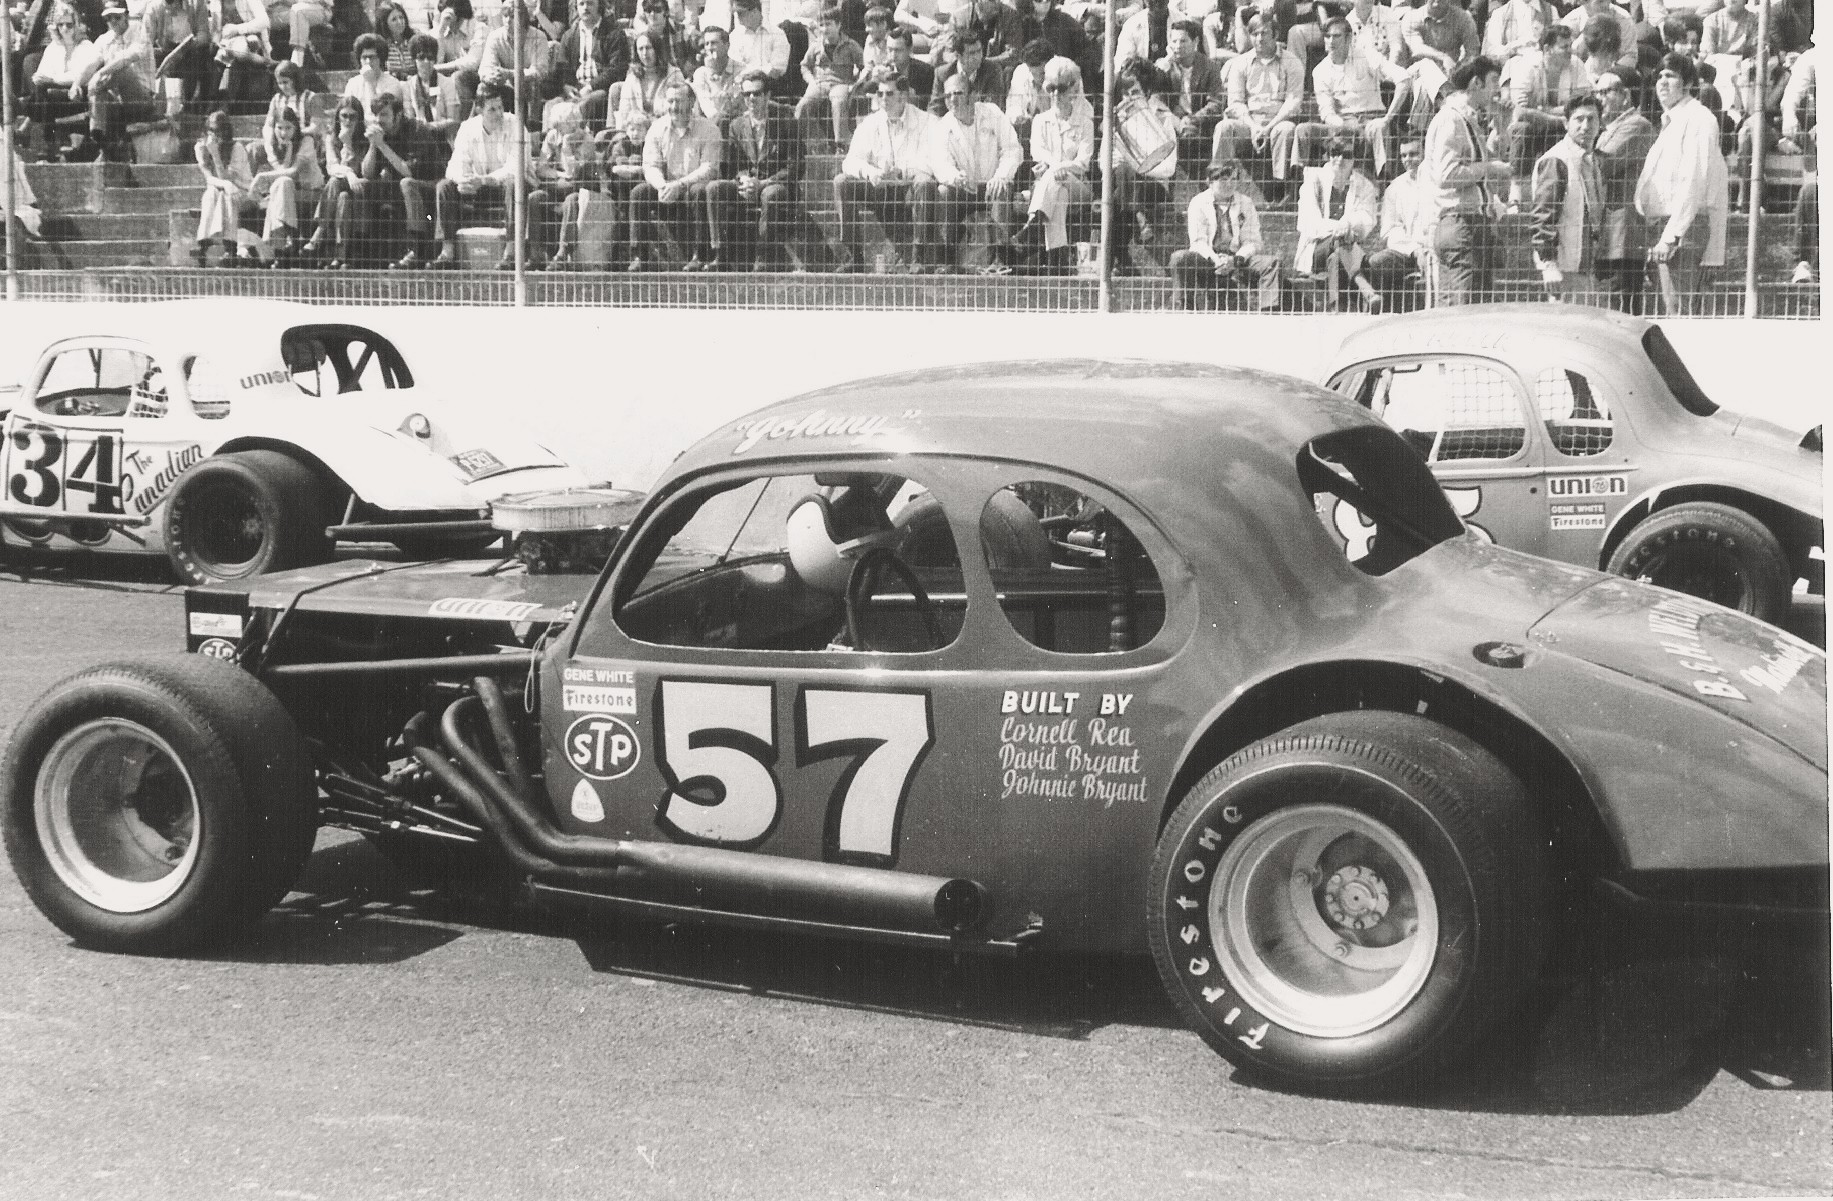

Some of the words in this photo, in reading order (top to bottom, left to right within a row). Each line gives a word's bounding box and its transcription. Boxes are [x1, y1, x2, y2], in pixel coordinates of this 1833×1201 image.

[10, 423, 125, 514] 34
[126, 449, 153, 474] The
[1550, 505, 1575, 514] GENE
[1576, 504, 1604, 513] WHITE
[1552, 517, 1603, 527] Firestone
[563, 667, 595, 682] GENE
[595, 670, 634, 684] WHITE
[565, 688, 634, 707] Firestone
[1001, 690, 1080, 713] BUILT
[1100, 693, 1133, 714] BY
[572, 721, 633, 771] STP
[1000, 716, 1078, 744] Cornell
[1088, 717, 1136, 746] Rea
[655, 677, 934, 866] 57
[998, 743, 1059, 770] David
[1065, 744, 1143, 776] Bryant
[1000, 768, 1077, 799] Johnnie
[1082, 773, 1148, 809] Bryant
[1176, 805, 1271, 1050] Firestone
